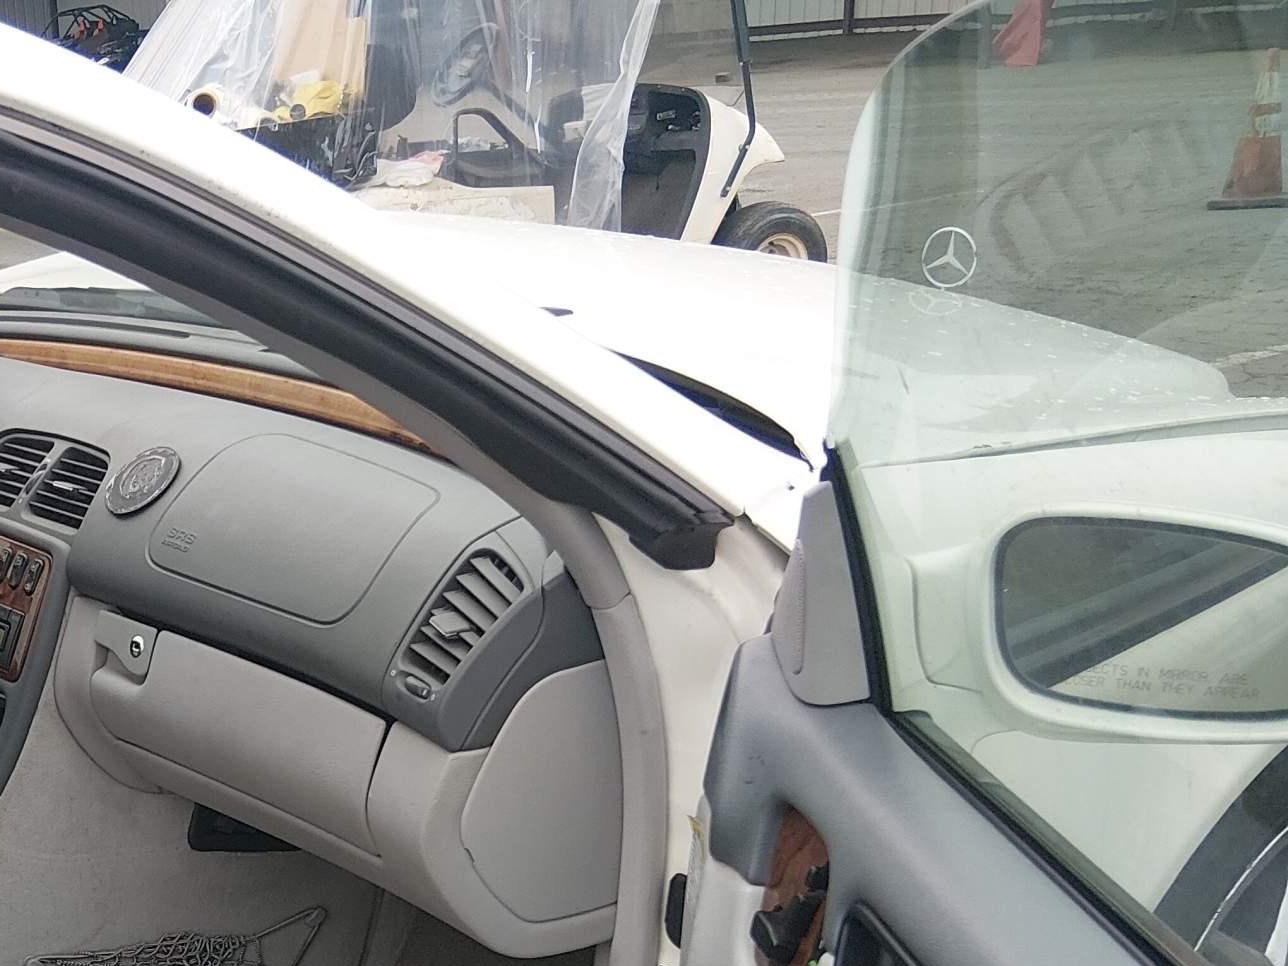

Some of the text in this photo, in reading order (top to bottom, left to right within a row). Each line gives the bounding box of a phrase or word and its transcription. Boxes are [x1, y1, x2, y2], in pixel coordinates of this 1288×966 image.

[1086, 663, 1249, 686] ECTS IN MIRROR ARE
[1063, 675, 1261, 700] OSER THAN THEY APPEAR
